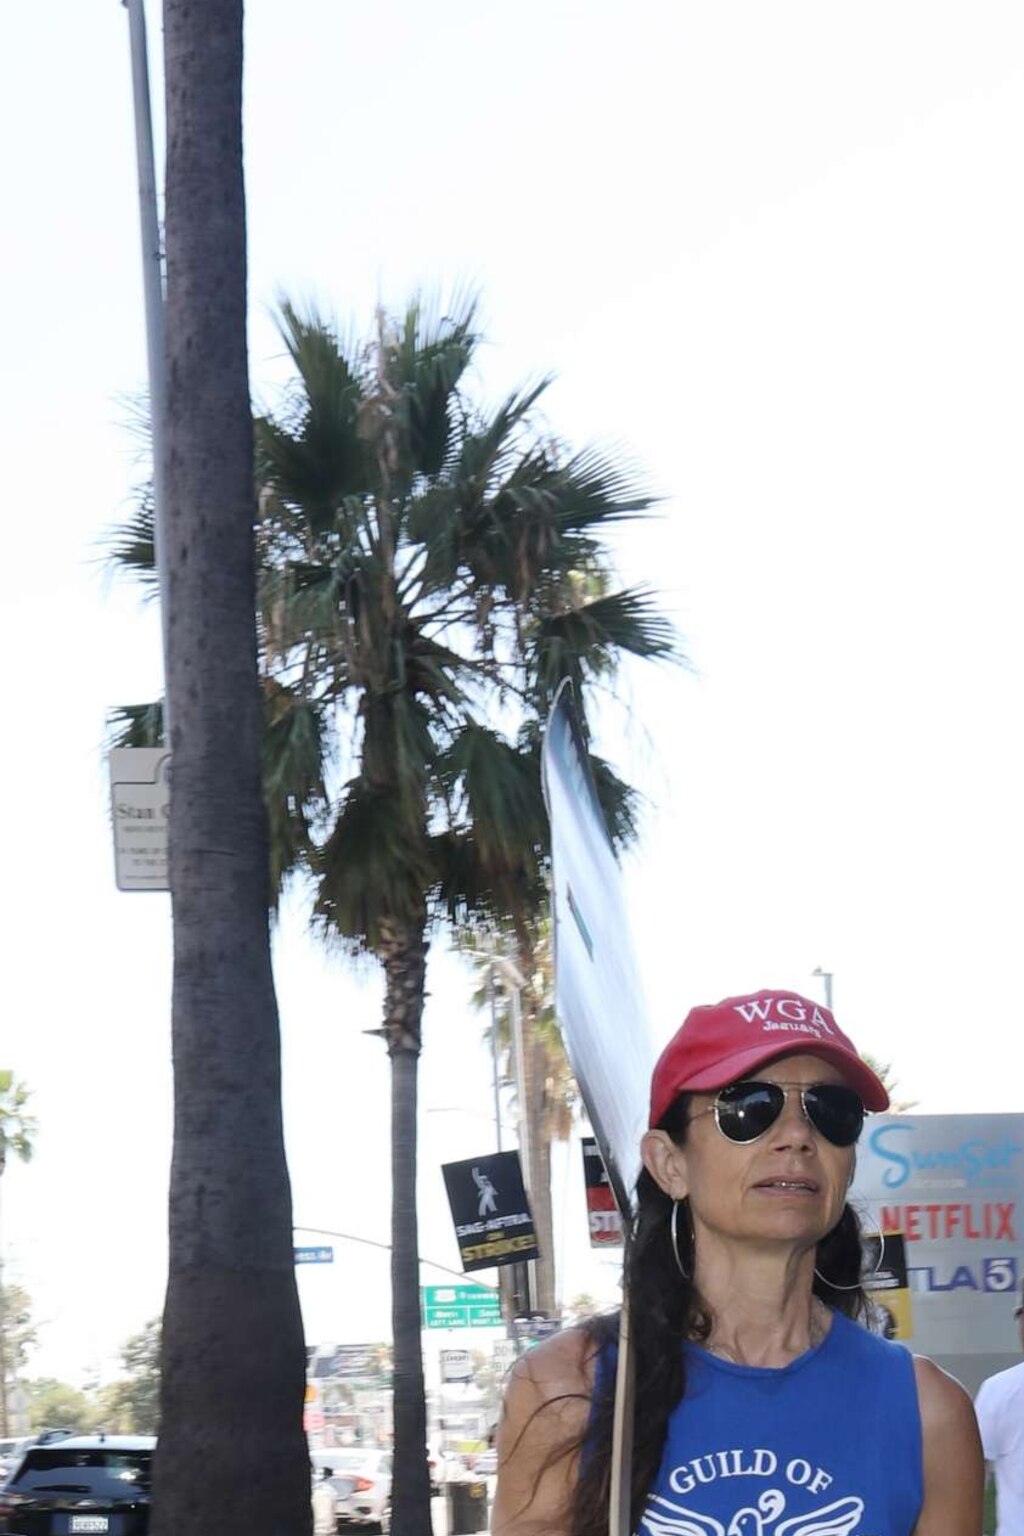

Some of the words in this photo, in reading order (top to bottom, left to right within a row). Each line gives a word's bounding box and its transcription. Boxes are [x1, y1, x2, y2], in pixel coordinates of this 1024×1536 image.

[733, 998, 834, 1035] WGA
[869, 1123, 1023, 1189] Sunset
[882, 1202, 1016, 1241] NETFLIX
[669, 1449, 778, 1494] GUILD
[785, 1458, 833, 1495] OF
